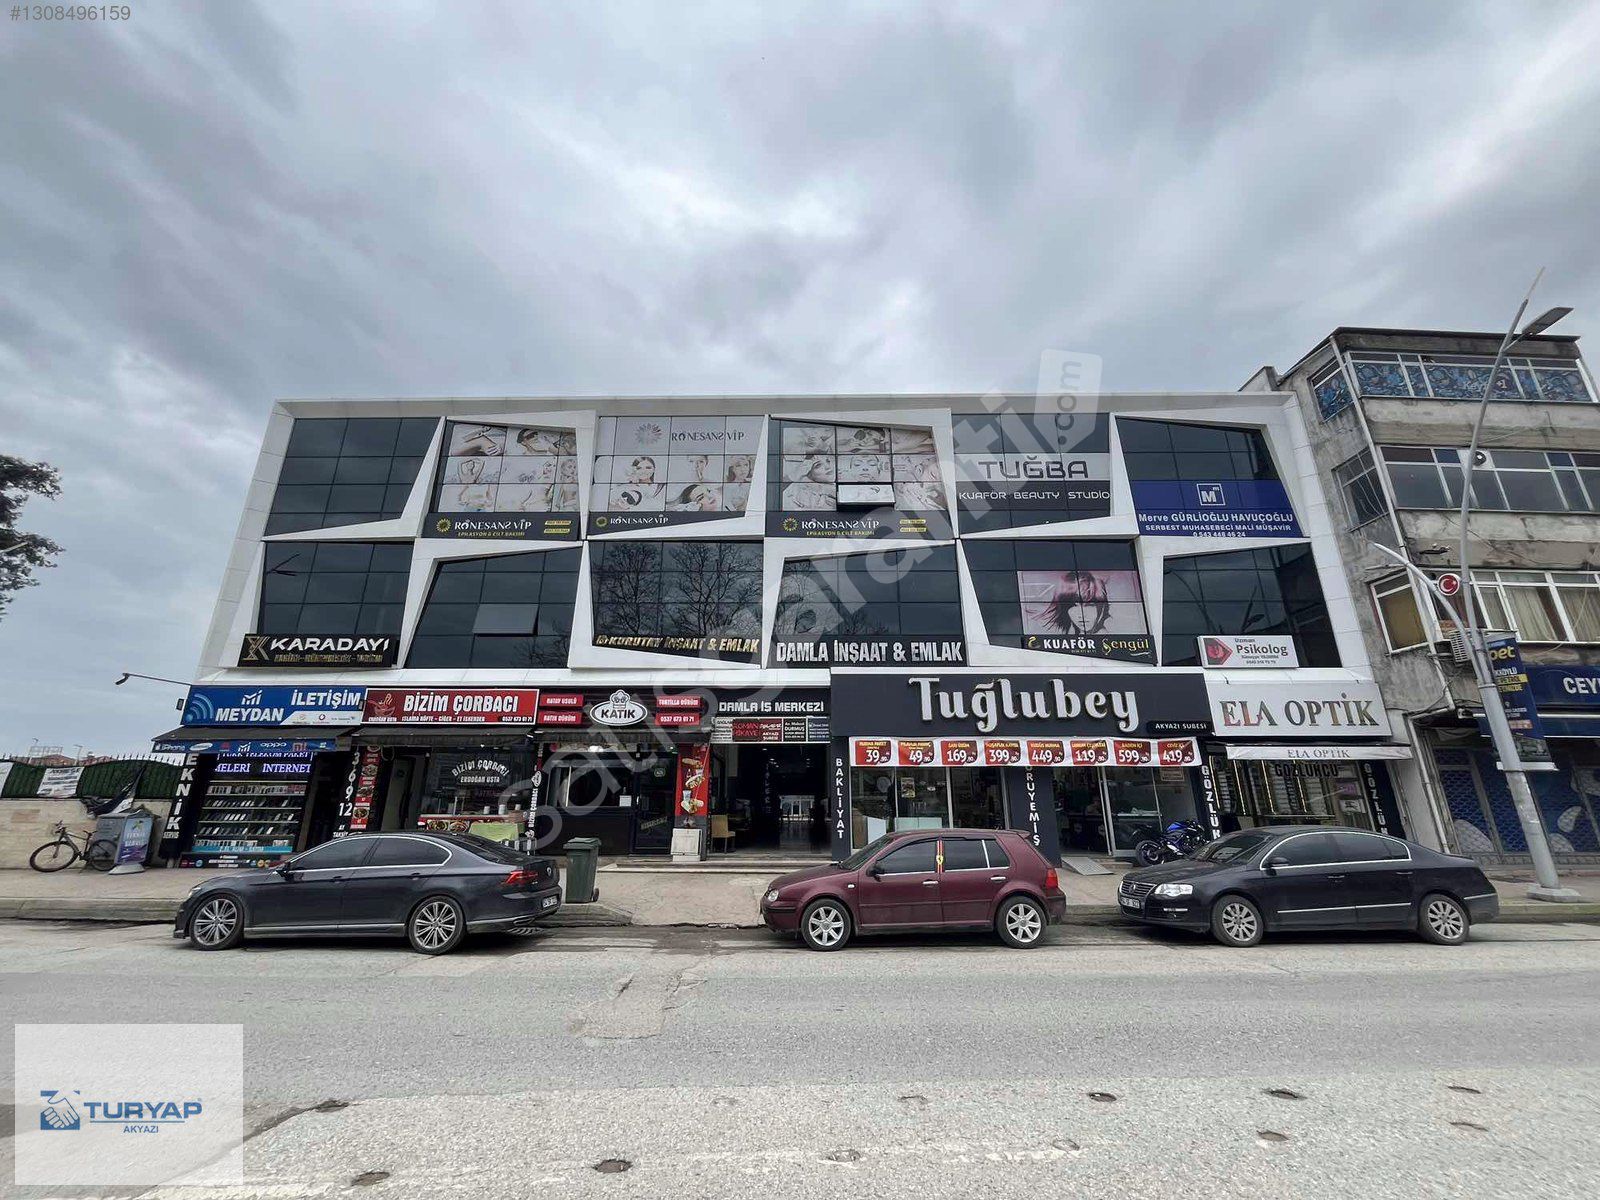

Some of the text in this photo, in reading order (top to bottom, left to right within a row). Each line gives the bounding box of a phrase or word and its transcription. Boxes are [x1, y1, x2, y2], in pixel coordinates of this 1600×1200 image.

[978, 455, 1089, 479] TUĞBA
[1013, 491, 1060, 500] BEAUTY
[1139, 511, 1293, 524] Merve GÜRLİOĞLU HAVUÇOĞLU
[270, 637, 389, 651] KARADAYI
[708, 639, 718, 650] &
[719, 638, 760, 653] EMLAK
[1043, 636, 1149, 656] KUAFÖR Şengül
[1236, 644, 1288, 657] Psikolog
[776, 639, 963, 663] DAMLA İNŞAAT & EMLAK
[290, 689, 361, 709] İLETİŞİM
[403, 692, 519, 716] BİZİM ÇORBACI
[908, 677, 1140, 733] Tuğlubey
[718, 700, 824, 713] DAMLA İŞ MERKEZİ
[1219, 692, 1380, 726] ELA OPTİK
[215, 708, 284, 722] MEYDAN
[601, 708, 636, 719] KATIK
[1155, 722, 1180, 730] AKYAZI
[866, 750, 880, 762] 39
[909, 750, 923, 763] 49
[946, 750, 967, 762] 169
[989, 750, 1010, 762] 399
[1031, 750, 1053, 762] 449
[1075, 750, 1096, 762] 119
[1118, 750, 1140, 762] 599
[1162, 750, 1183, 763] 419
[348, 769, 357, 782] 6
[345, 785, 354, 799] 9
[835, 758, 846, 839] BAKLİYAT
[338, 802, 353, 816] 12
